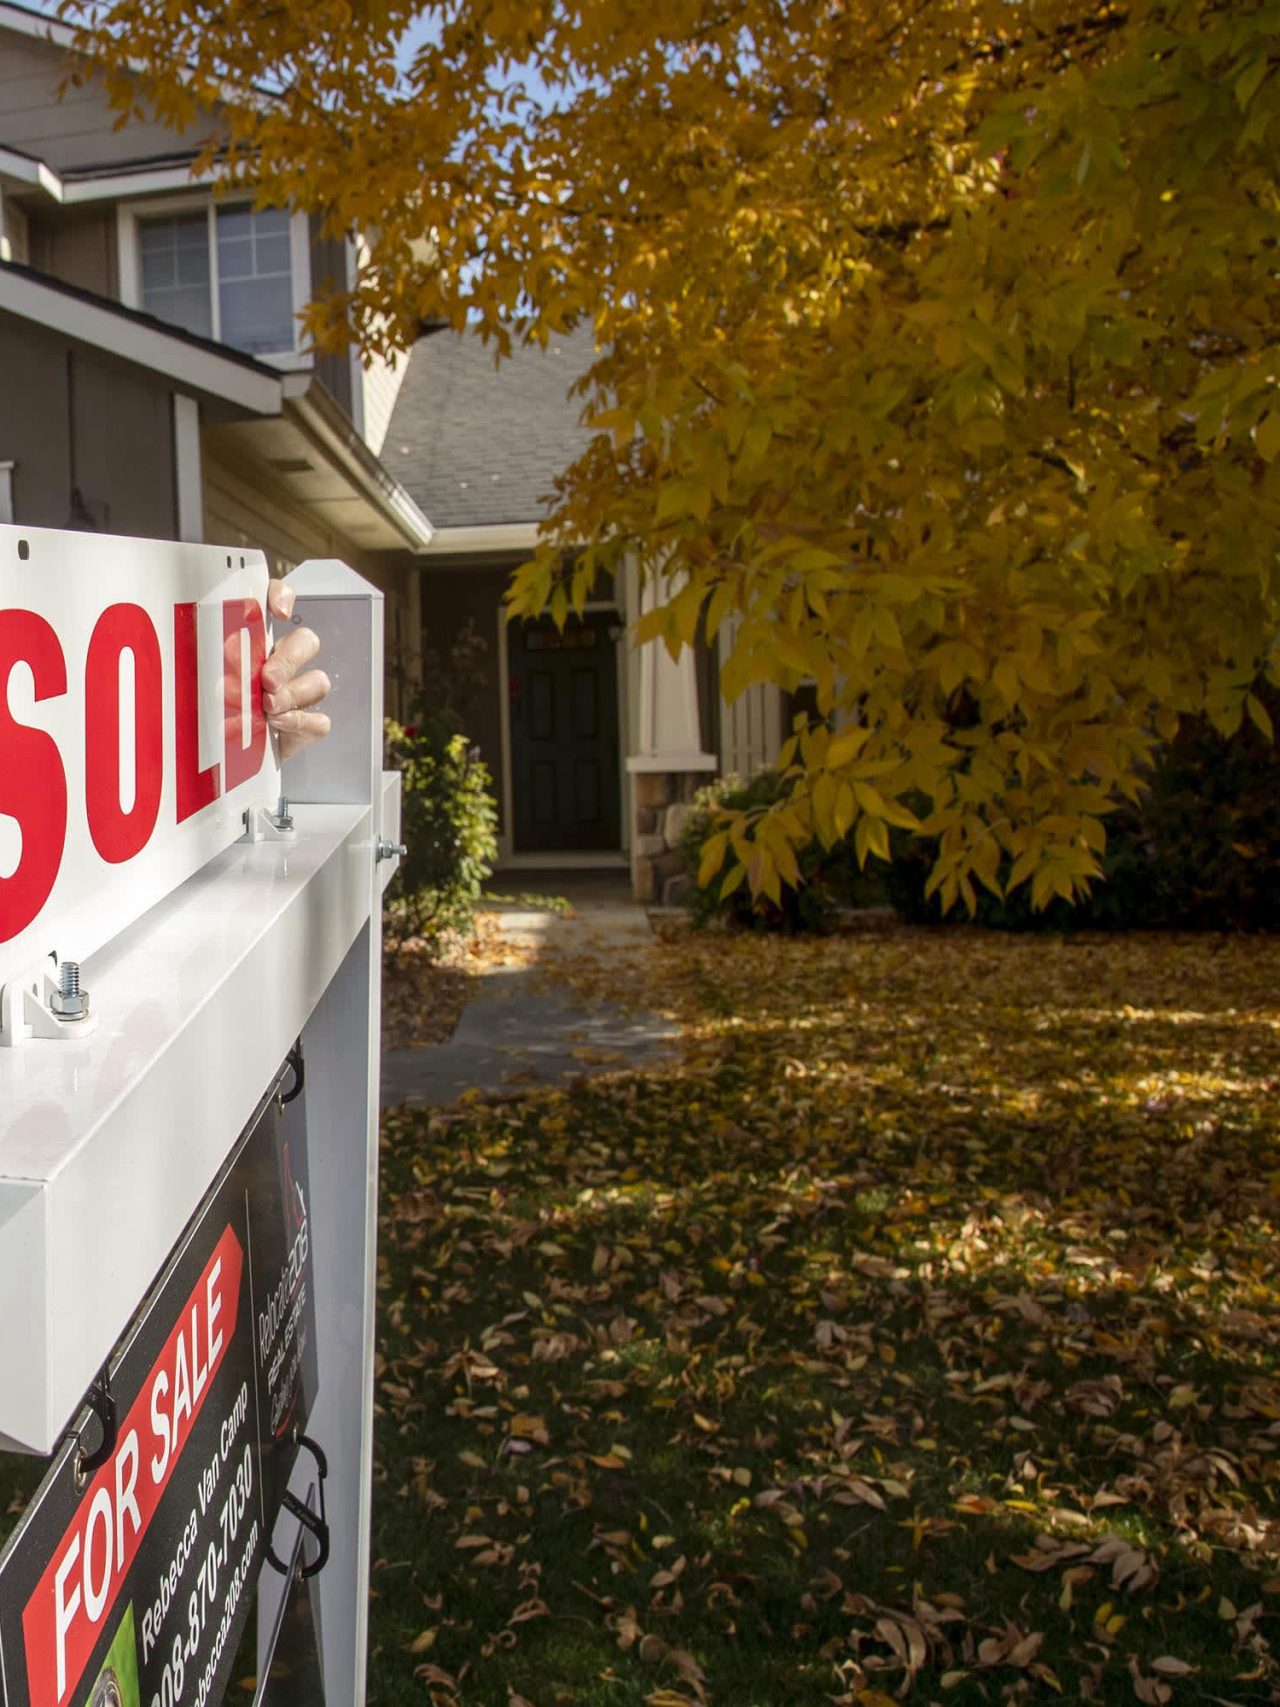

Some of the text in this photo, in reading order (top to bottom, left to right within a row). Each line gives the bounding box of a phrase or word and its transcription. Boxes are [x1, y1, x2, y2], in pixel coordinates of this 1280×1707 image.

[54, 1256, 224, 1704] FOR SALE
[141, 1381, 248, 1666] Rebecca Van Camp
